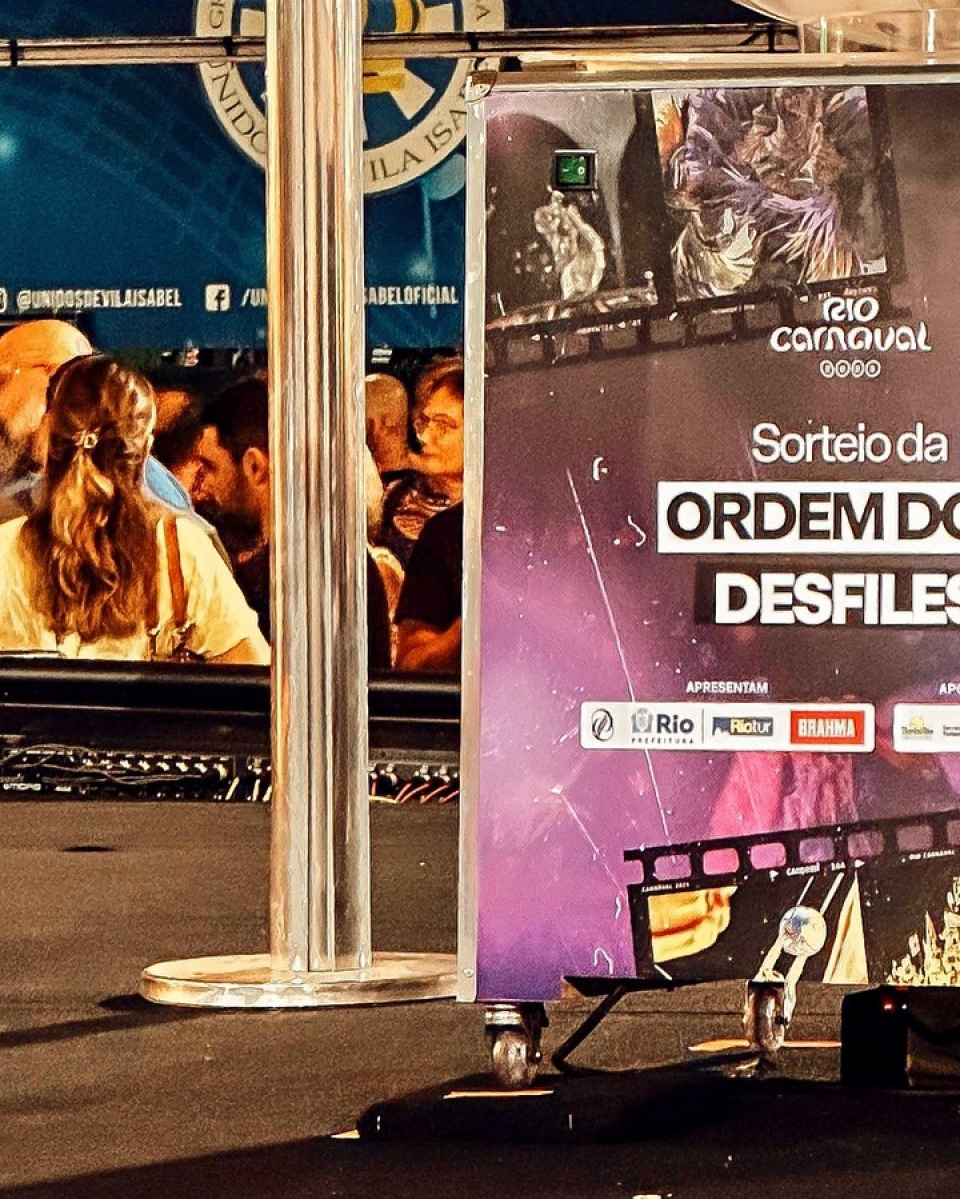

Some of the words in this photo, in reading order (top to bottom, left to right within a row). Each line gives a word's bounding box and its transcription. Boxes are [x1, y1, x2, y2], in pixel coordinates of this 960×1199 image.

[17, 287, 183, 309] @UNIDOSDEVILAISABEL
[823, 296, 880, 322] RIO
[769, 321, 932, 352] carnaval
[751, 422, 891, 463] Sorteio
[897, 423, 949, 463] da
[666, 491, 885, 541] ORDEM
[686, 680, 769, 694] APRESENTAM
[656, 713, 694, 734] Rio
[729, 717, 772, 736] Riotur
[797, 718, 856, 738] BRAHMA
